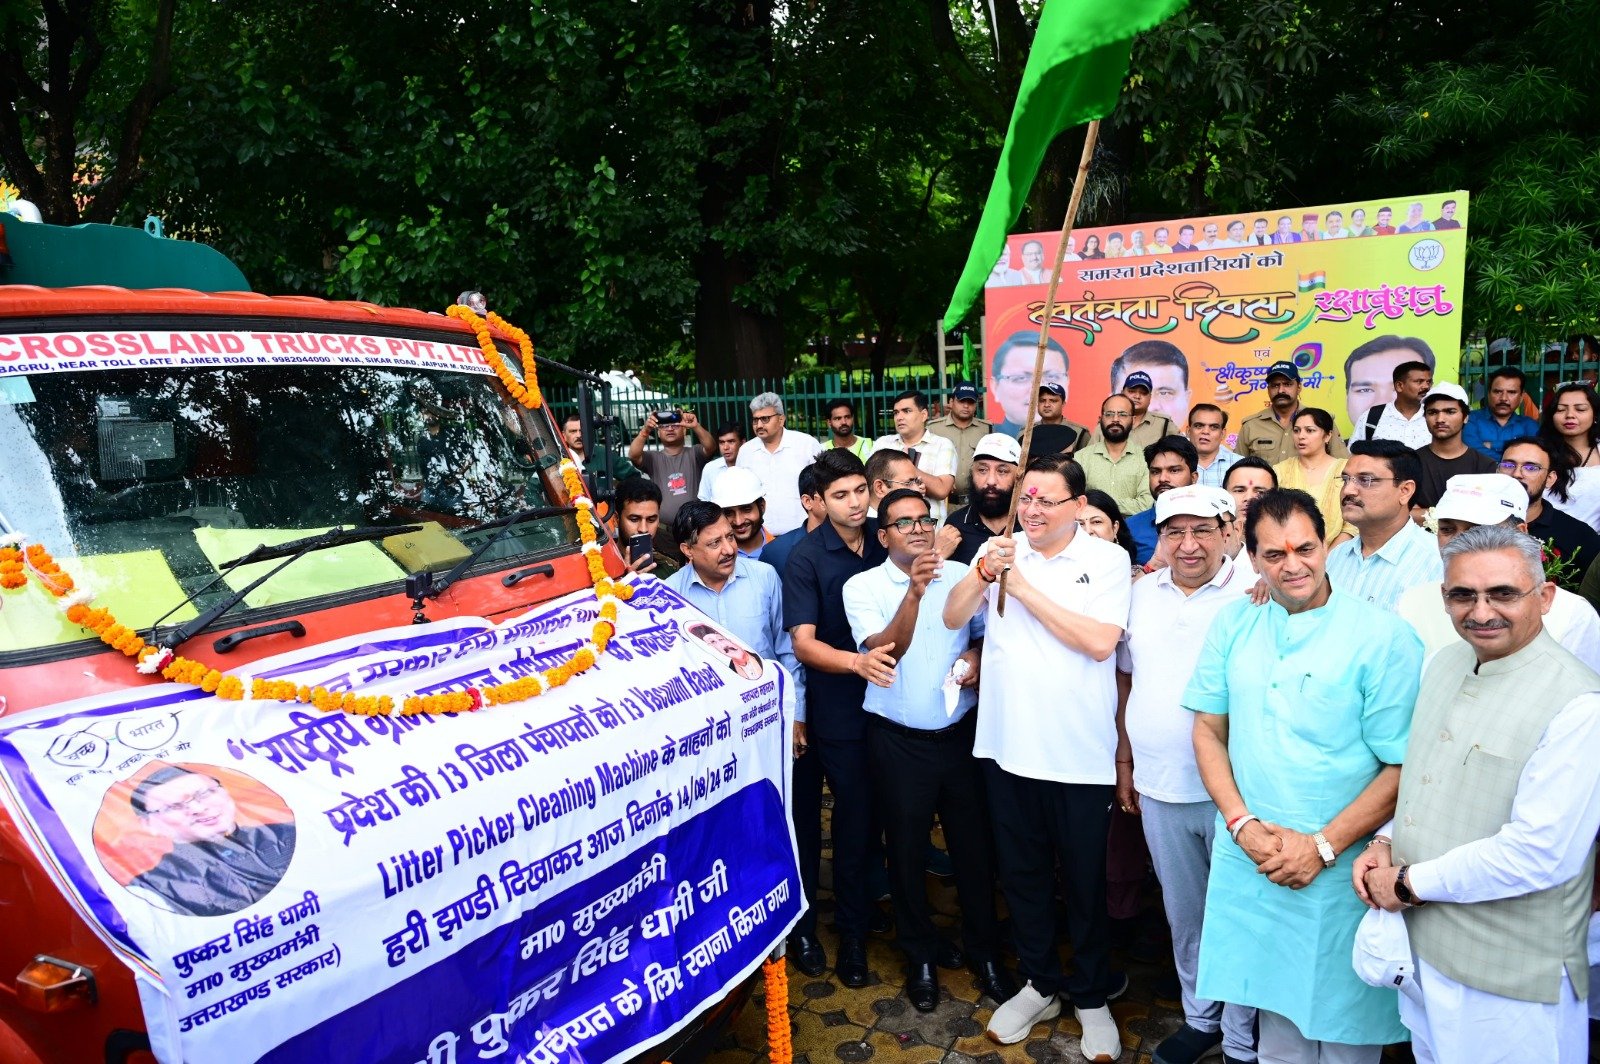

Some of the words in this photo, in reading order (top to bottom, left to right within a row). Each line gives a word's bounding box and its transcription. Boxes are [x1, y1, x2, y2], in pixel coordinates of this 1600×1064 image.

[1078, 265, 1135, 281] समस्त
[1138, 252, 1254, 278] प्रदेशवासियों
[1257, 250, 1284, 268] को
[1172, 281, 1296, 344] दिवस
[1314, 283, 1454, 330] रक्षाबंधन
[0, 333, 245, 362] CROSSLAND
[251, 333, 381, 355] TRUCKS
[385, 339, 443, 360] PVT.
[0, 363, 55, 374] BAGRU,
[57, 360, 97, 369] NEAR
[100, 358, 136, 367] TOLL
[140, 357, 173, 365] GATE
[180, 357, 221, 365] AJMER
[421, 360, 449, 369] JAIPUR
[1254, 347, 1271, 361] एवं
[129, 719, 165, 738] भारत
[322, 791, 401, 847] प्रदेश
[391, 764, 441, 807] की
[437, 762, 468, 793] 13
[455, 743, 529, 781] जिला
[519, 704, 600, 757] पंचायतों
[589, 696, 626, 729] को
[619, 697, 645, 720] 13
[679, 661, 725, 695] Based
[377, 844, 444, 899] Litter
[446, 811, 515, 866] Picker
[517, 773, 596, 831] Cleaning
[594, 749, 659, 797] Machine
[661, 734, 677, 766] के
[679, 717, 714, 758] वाहनों
[715, 710, 732, 741] को
[382, 909, 430, 968] हरी
[432, 873, 499, 941] झण्डी
[499, 839, 584, 903] दिखाकर
[586, 818, 626, 860] आज
[626, 788, 674, 837] दिनांक
[676, 767, 721, 811] 14/08/24
[722, 752, 738, 784] को
[572, 853, 667, 937] मुख्यमंत्री
[172, 933, 232, 978] पुष्कर
[233, 913, 274, 947] सिंह
[277, 890, 321, 926] धामी
[229, 923, 320, 982] मुख्यमंत्री
[570, 926, 634, 985] सिंह
[697, 858, 729, 903] जी
[610, 977, 643, 1016] के
[644, 961, 684, 1004] लिए
[682, 925, 733, 977] रवाना
[728, 899, 768, 942] किया
[765, 878, 790, 912] गया
[178, 980, 271, 1033] उत्तराखण्ड
[274, 942, 341, 989] सरकार)
